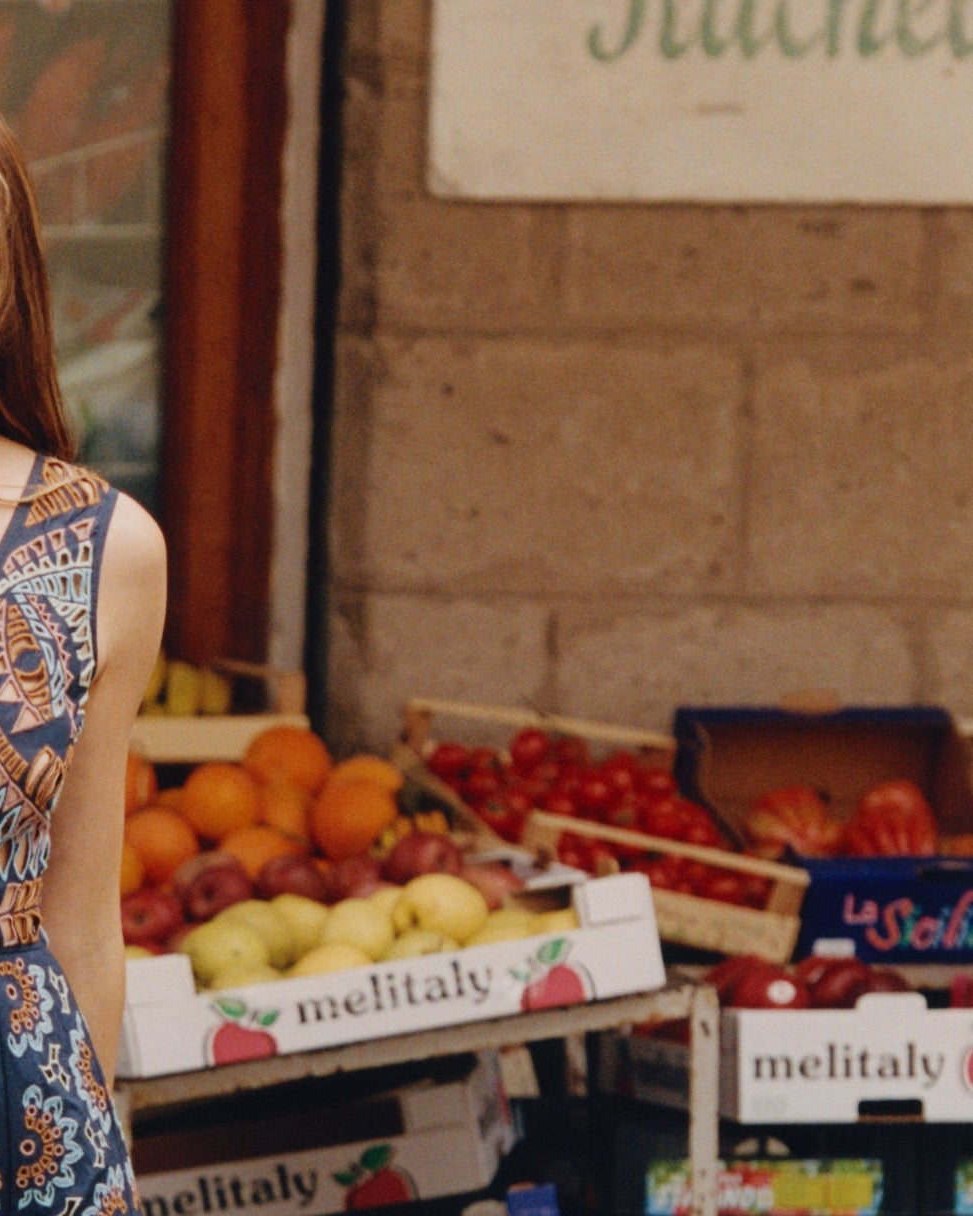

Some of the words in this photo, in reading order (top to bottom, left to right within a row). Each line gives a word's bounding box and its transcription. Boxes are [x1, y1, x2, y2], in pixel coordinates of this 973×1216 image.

[844, 894, 878, 925] La
[865, 889, 973, 951] Sicili
[296, 960, 493, 1025] melitaly
[753, 1042, 945, 1089] melitaly
